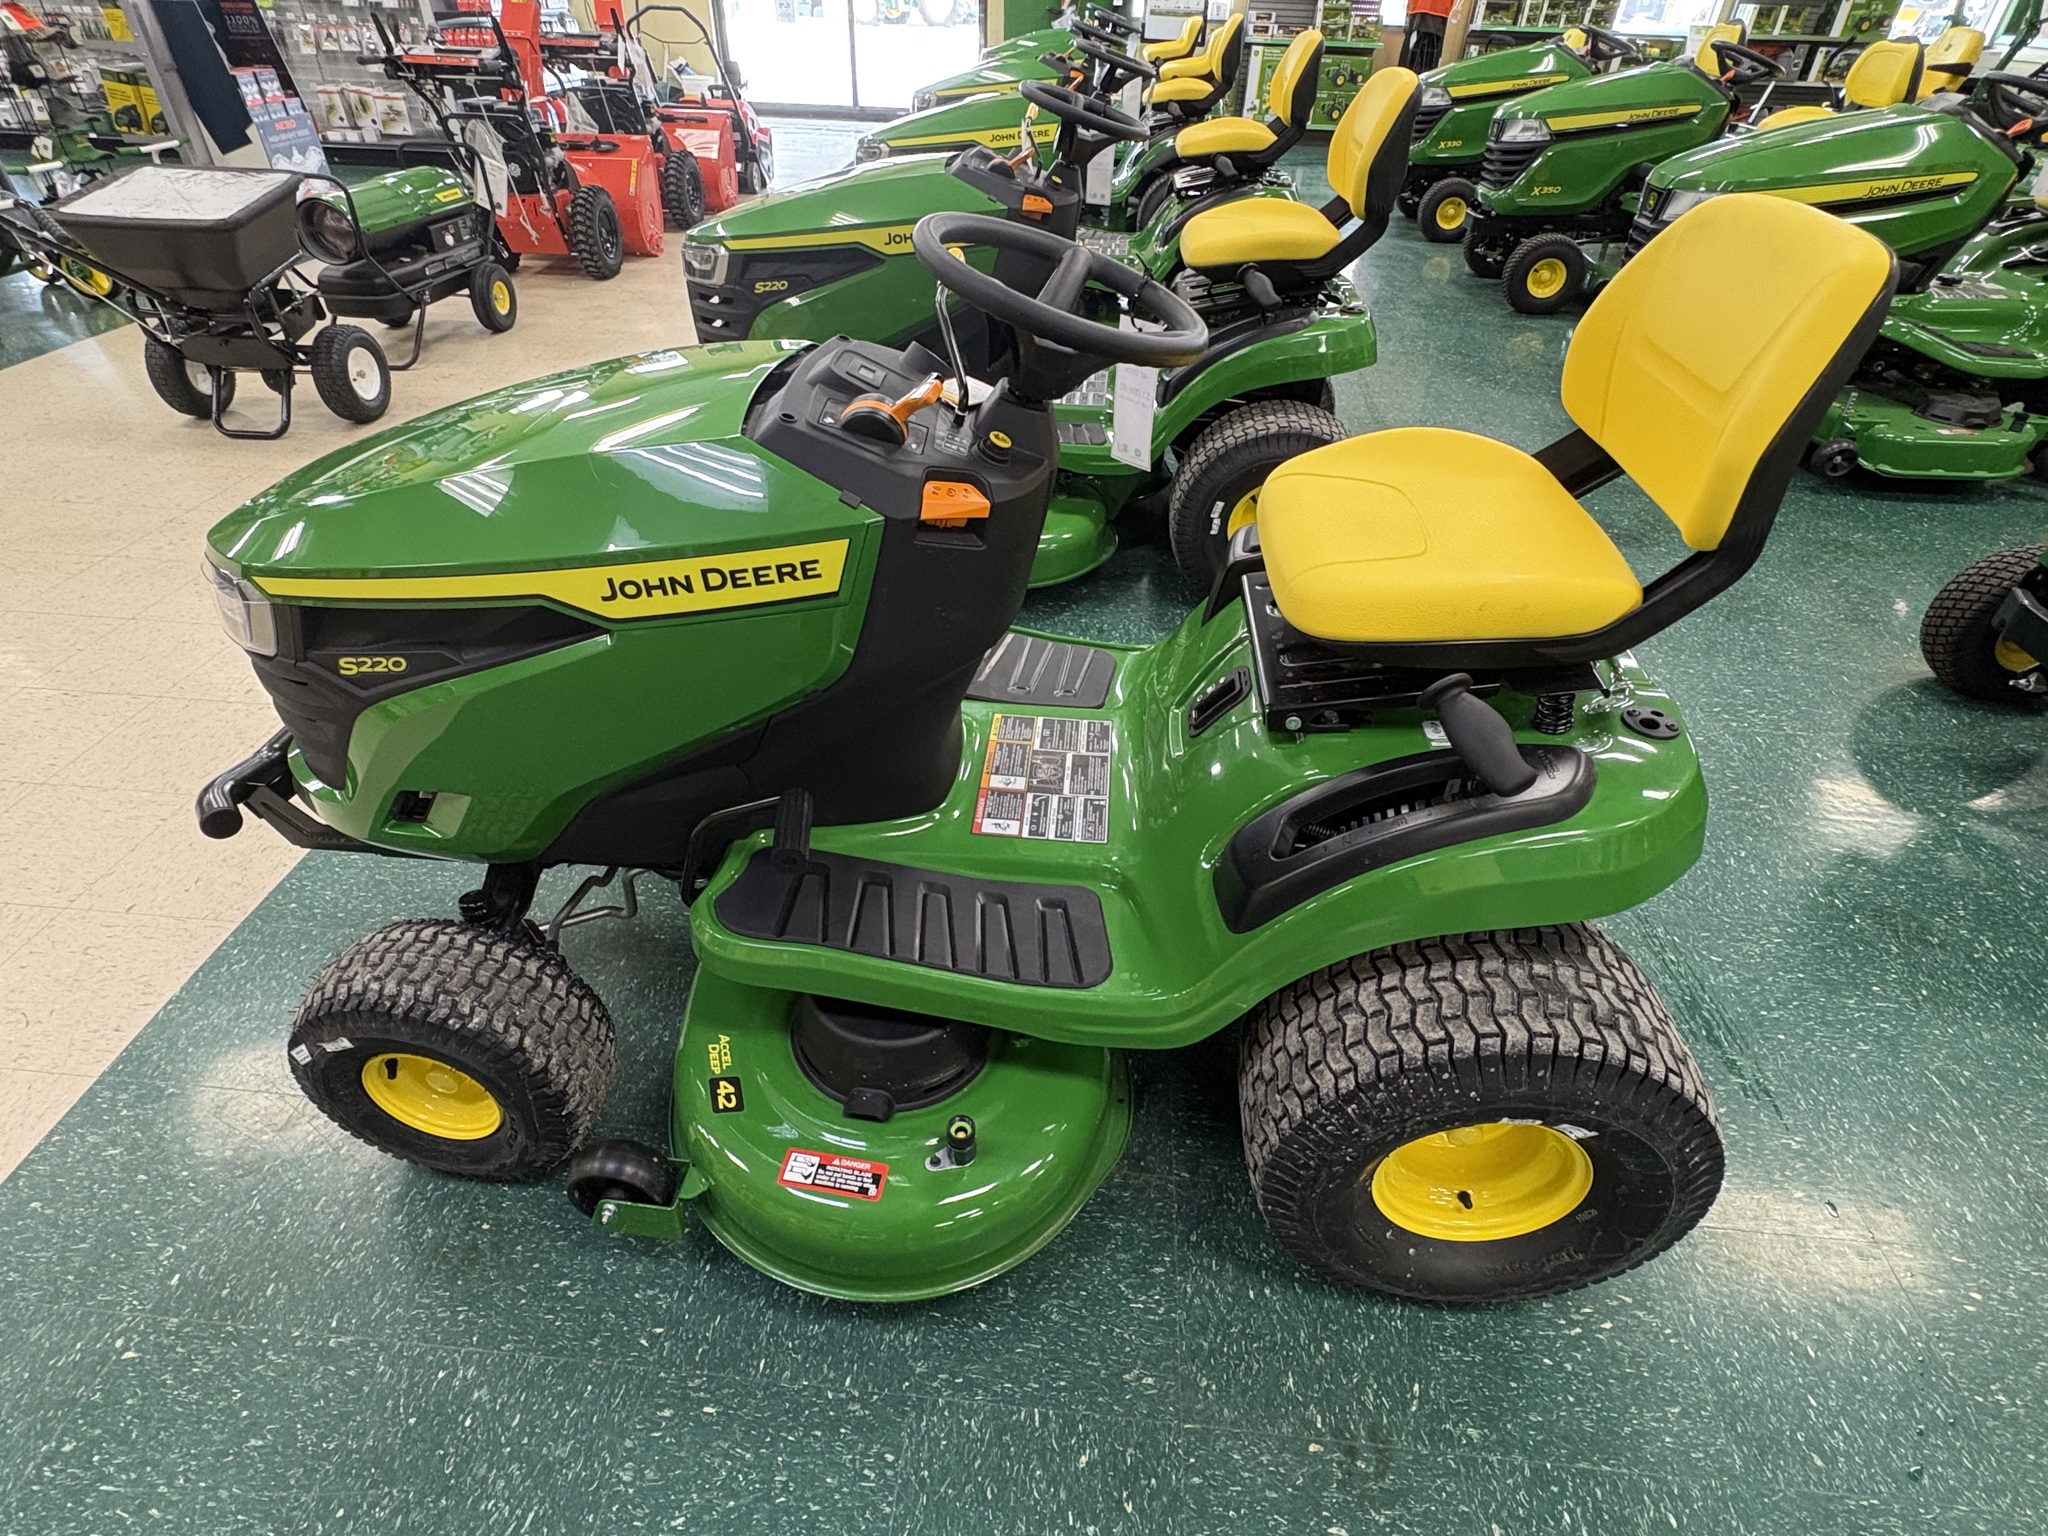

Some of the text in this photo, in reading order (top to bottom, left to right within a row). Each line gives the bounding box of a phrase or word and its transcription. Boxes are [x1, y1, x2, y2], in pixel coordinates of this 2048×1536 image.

[1627, 107, 1680, 121] JOHN DEERE
[989, 133, 1015, 142] JOHN
[1438, 140, 1462, 149] X330
[1530, 186, 1561, 196] X350
[1862, 177, 1944, 197] JOHN DEERE
[884, 232, 914, 246] JOH
[754, 280, 788, 293] S220
[600, 559, 822, 602] JOHN DEERE
[339, 656, 407, 676] S220
[718, 1034, 732, 1070] ACCEL
[708, 1044, 721, 1075] DEEP
[716, 1080, 737, 1109] 42
[825, 1165, 853, 1175] ROTATING
[840, 1158, 872, 1170] DANGER
